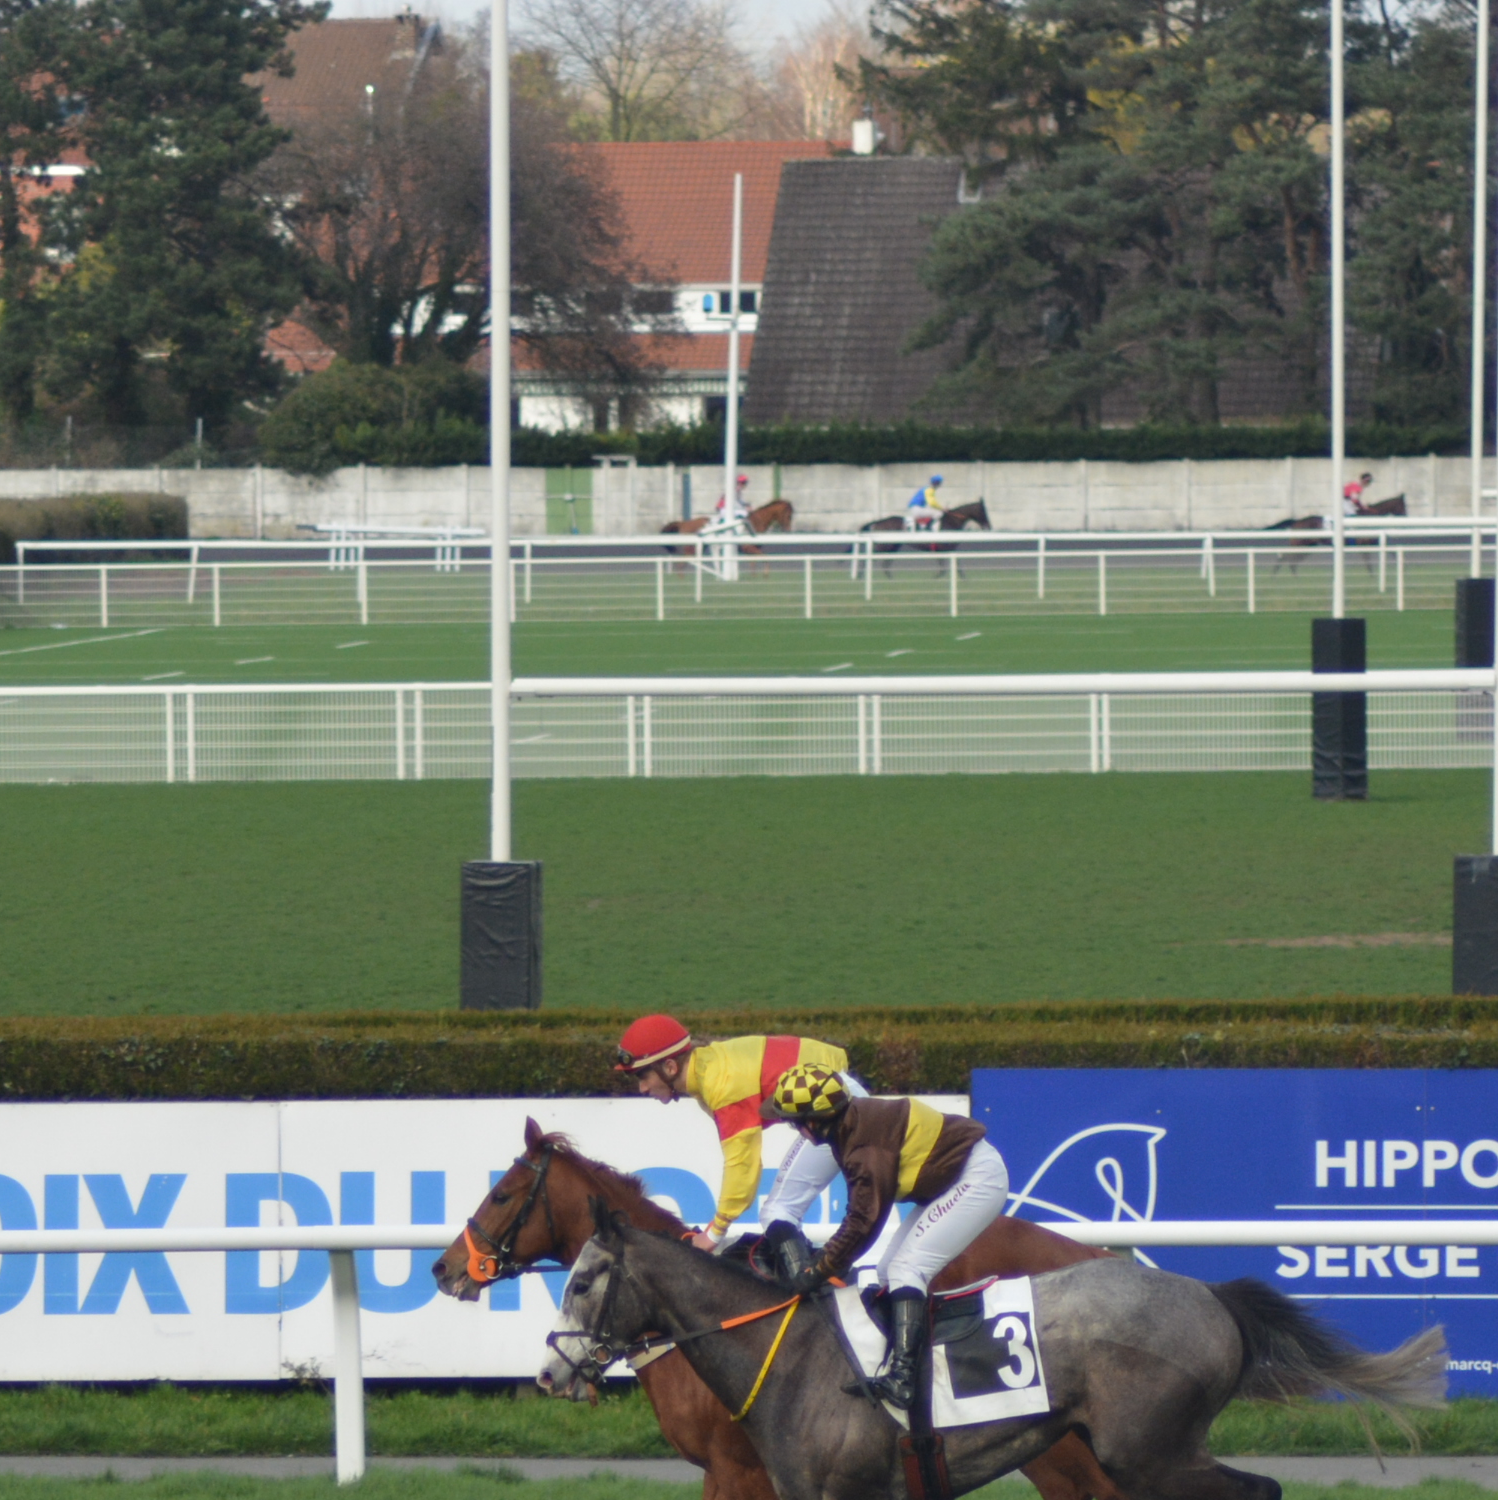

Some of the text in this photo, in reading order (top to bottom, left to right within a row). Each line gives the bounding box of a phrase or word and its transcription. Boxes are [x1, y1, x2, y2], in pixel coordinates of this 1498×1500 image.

[224, 1170, 447, 1316] DU
[1275, 1243, 1481, 1279] SERGE
[993, 1315, 1036, 1389] 3
